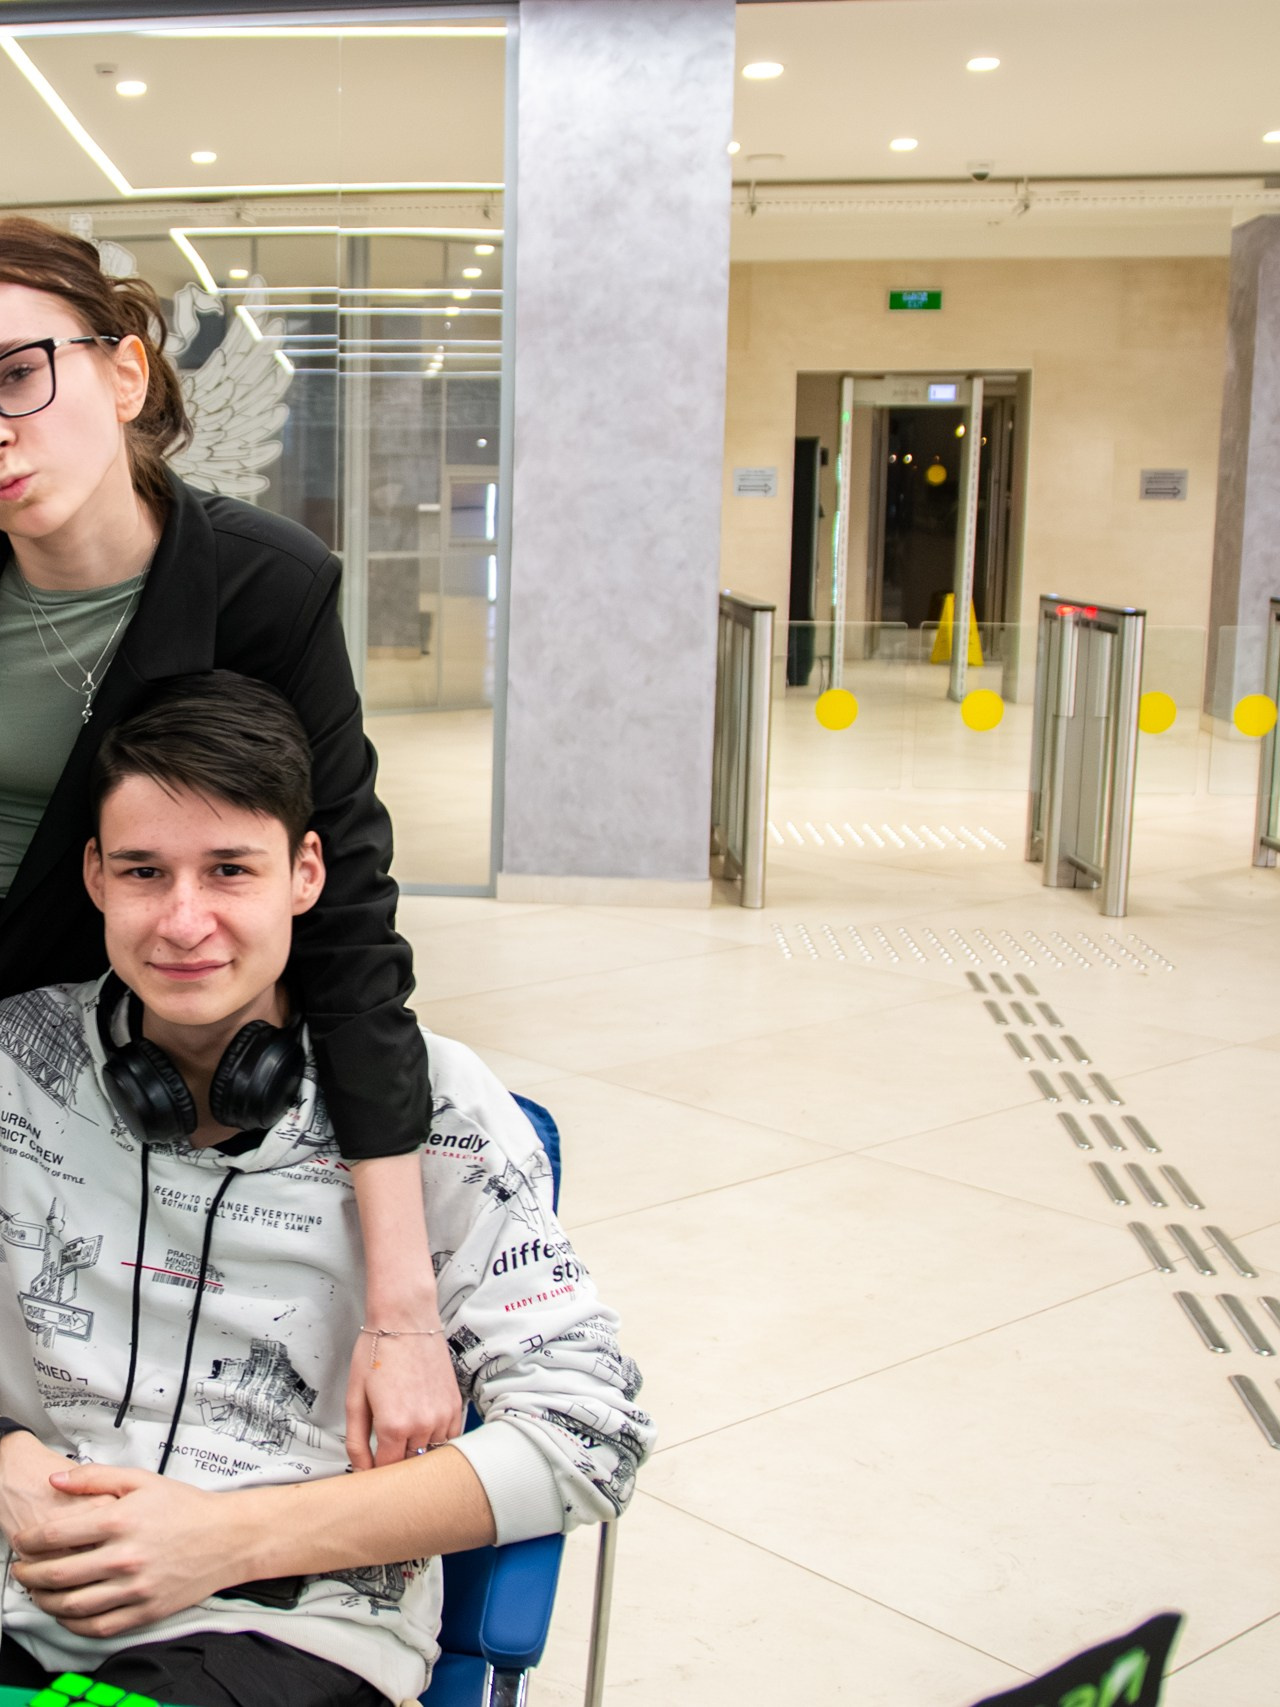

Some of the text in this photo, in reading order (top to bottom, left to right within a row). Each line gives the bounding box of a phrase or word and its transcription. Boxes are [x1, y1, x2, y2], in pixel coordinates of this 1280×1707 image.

[1, 1110, 42, 1140] URBAN
[19, 1151, 39, 1164] GOES
[51, 1169, 61, 1178] OF
[29, 1139, 64, 1166] CREW
[320, 1177, 340, 1186] OUT
[153, 1185, 324, 1226] READY TO CANGE EVERYTHING
[232, 1212, 256, 1224] STAY
[261, 1218, 279, 1229] THE
[284, 1222, 311, 1234] SAME
[505, 1296, 533, 1312] READY
[536, 1292, 548, 1303] TO
[557, 1330, 586, 1341] NEW
[158, 1441, 228, 1466] PACTICING
